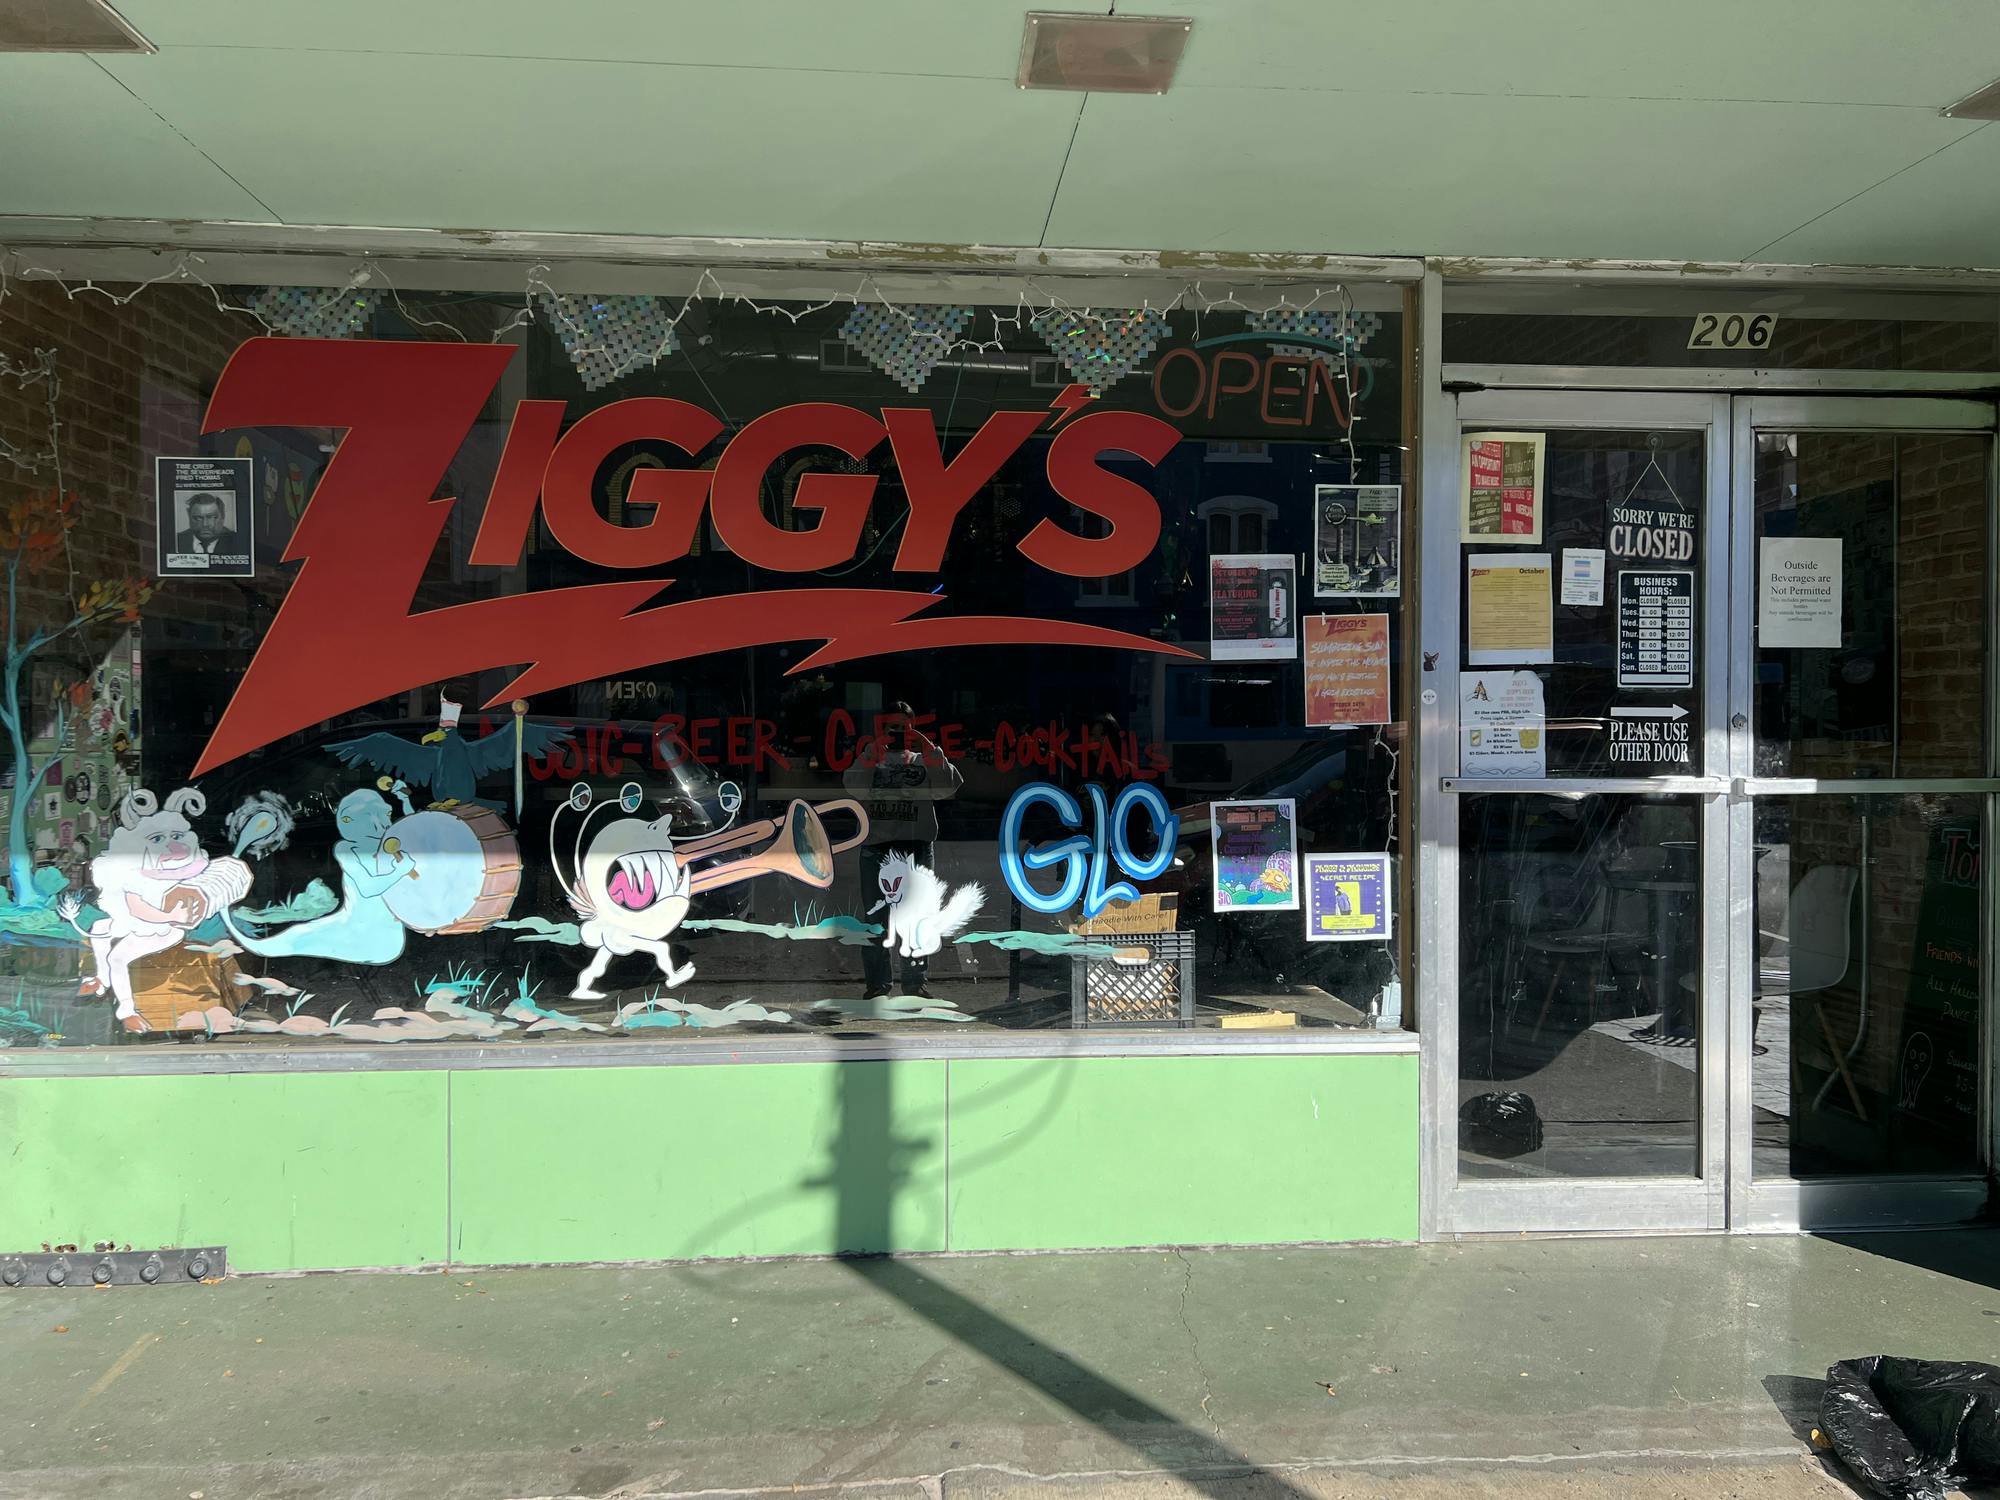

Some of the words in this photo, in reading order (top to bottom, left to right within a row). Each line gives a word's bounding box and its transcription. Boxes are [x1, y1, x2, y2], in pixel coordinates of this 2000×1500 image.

[1692, 315, 1772, 347] 206
[1154, 348, 1361, 429] OPEN
[1612, 507, 1655, 526] SORRY
[1658, 511, 1695, 529] WE'RE
[1609, 525, 1694, 560] CLOSED
[189, 336, 1205, 780] ZIGGY'S
[1784, 560, 1819, 570] Outside
[1519, 567, 1545, 575] October
[1634, 577, 1678, 587] BUSINESS
[1771, 573, 1816, 585] Beverages
[1818, 575, 1832, 583] are
[1213, 589, 1258, 600] FEATURING
[1639, 587, 1672, 596] HOURS:
[1771, 586, 1787, 595] Not
[1789, 586, 1831, 596] Permitted
[1621, 597, 1639, 605] Mon.
[1640, 597, 1659, 605] CLOSED
[1661, 597, 1668, 605] to
[1667, 597, 1687, 605] CLOSED
[1621, 608, 1640, 616] Tues.
[1661, 608, 1668, 616] to
[1325, 618, 1368, 637] ZIGGY'S
[1621, 619, 1639, 627] Wed.
[1661, 619, 1668, 627] to
[1621, 630, 1639, 638] Thur.
[1661, 630, 1668, 638] to
[1668, 630, 1686, 638] 12:00
[1621, 641, 1633, 649] Fri.
[1661, 641, 1668, 649] to
[1621, 652, 1636, 660] Sat.
[1661, 652, 1668, 660] to
[1621, 663, 1637, 671] Sun.
[1640, 663, 1659, 671] CLOSED
[1661, 663, 1668, 671] to
[1667, 663, 1687, 671] CLOSED
[1610, 722, 1660, 741] PLEASE
[1663, 722, 1689, 741] USE
[652, 713, 792, 773] BEER
[1609, 742, 1651, 762] OTHER
[1653, 742, 1689, 762] DOOR
[999, 782, 1180, 918] GLO
[1926, 942, 1962, 964] FRIENDS
